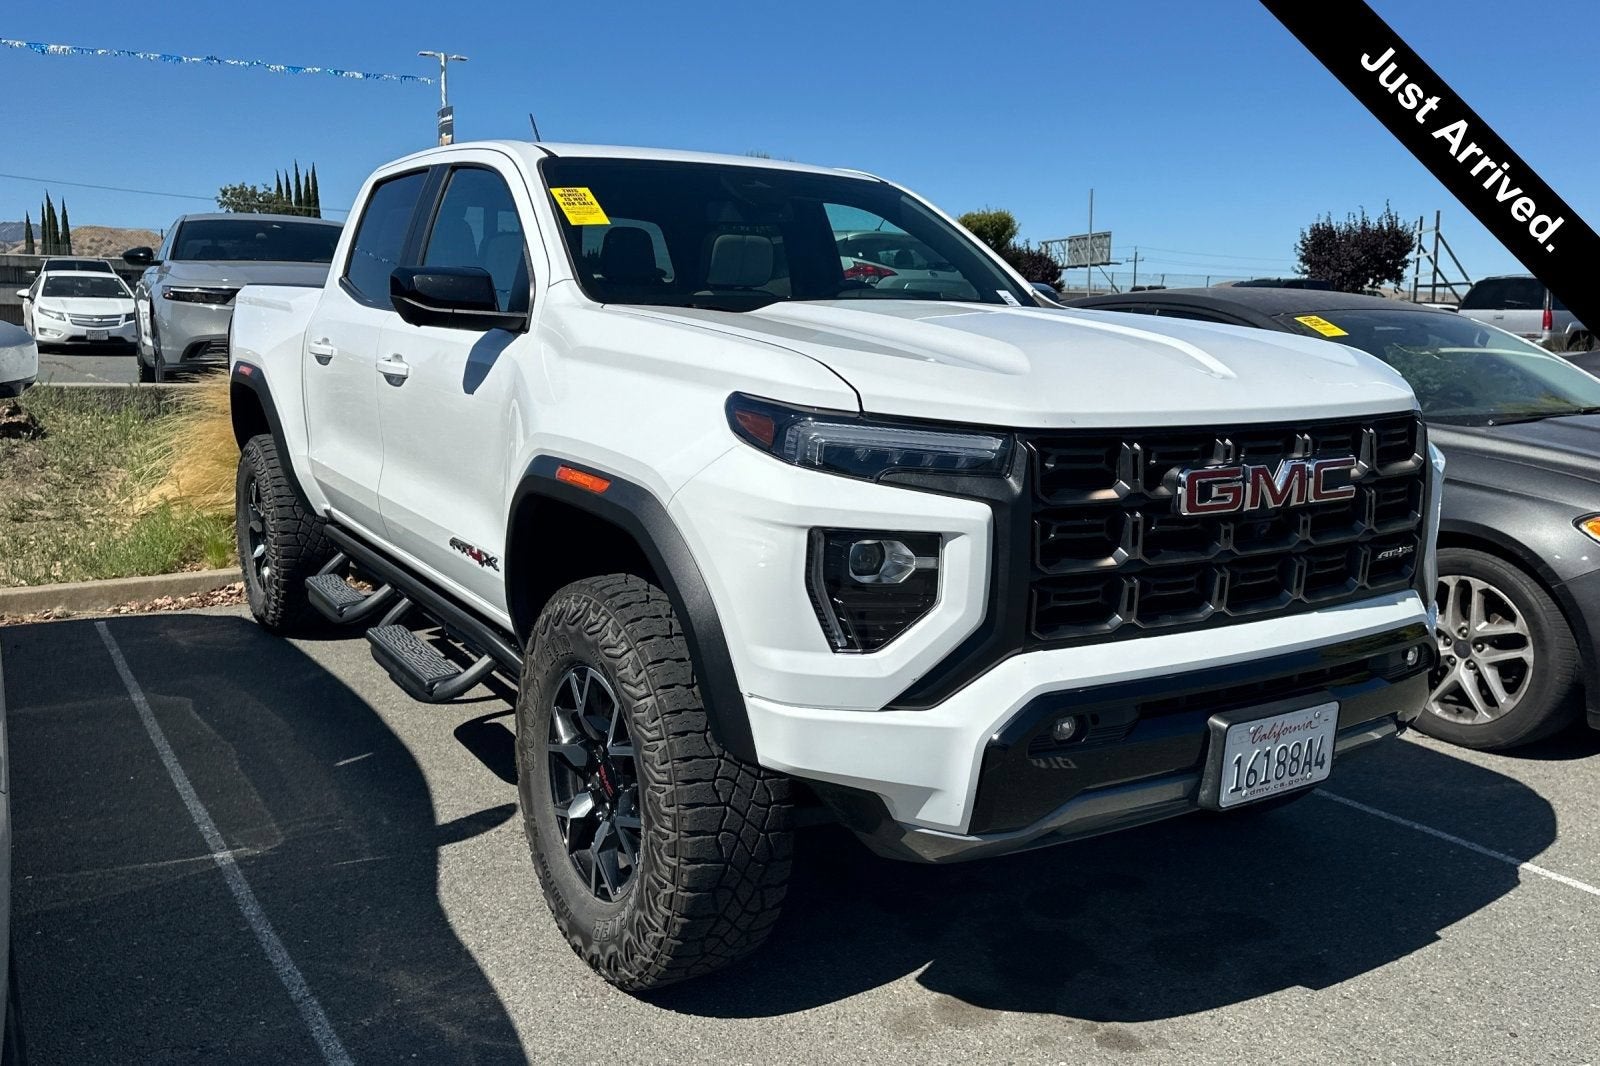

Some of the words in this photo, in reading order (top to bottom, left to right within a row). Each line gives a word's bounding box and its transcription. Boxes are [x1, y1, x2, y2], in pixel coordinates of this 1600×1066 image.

[1178, 457, 1356, 515] GMC
[1250, 716, 1320, 745] California
[1228, 734, 1327, 794] 16188A4
[1249, 777, 1306, 796] dmv.ca.gov
